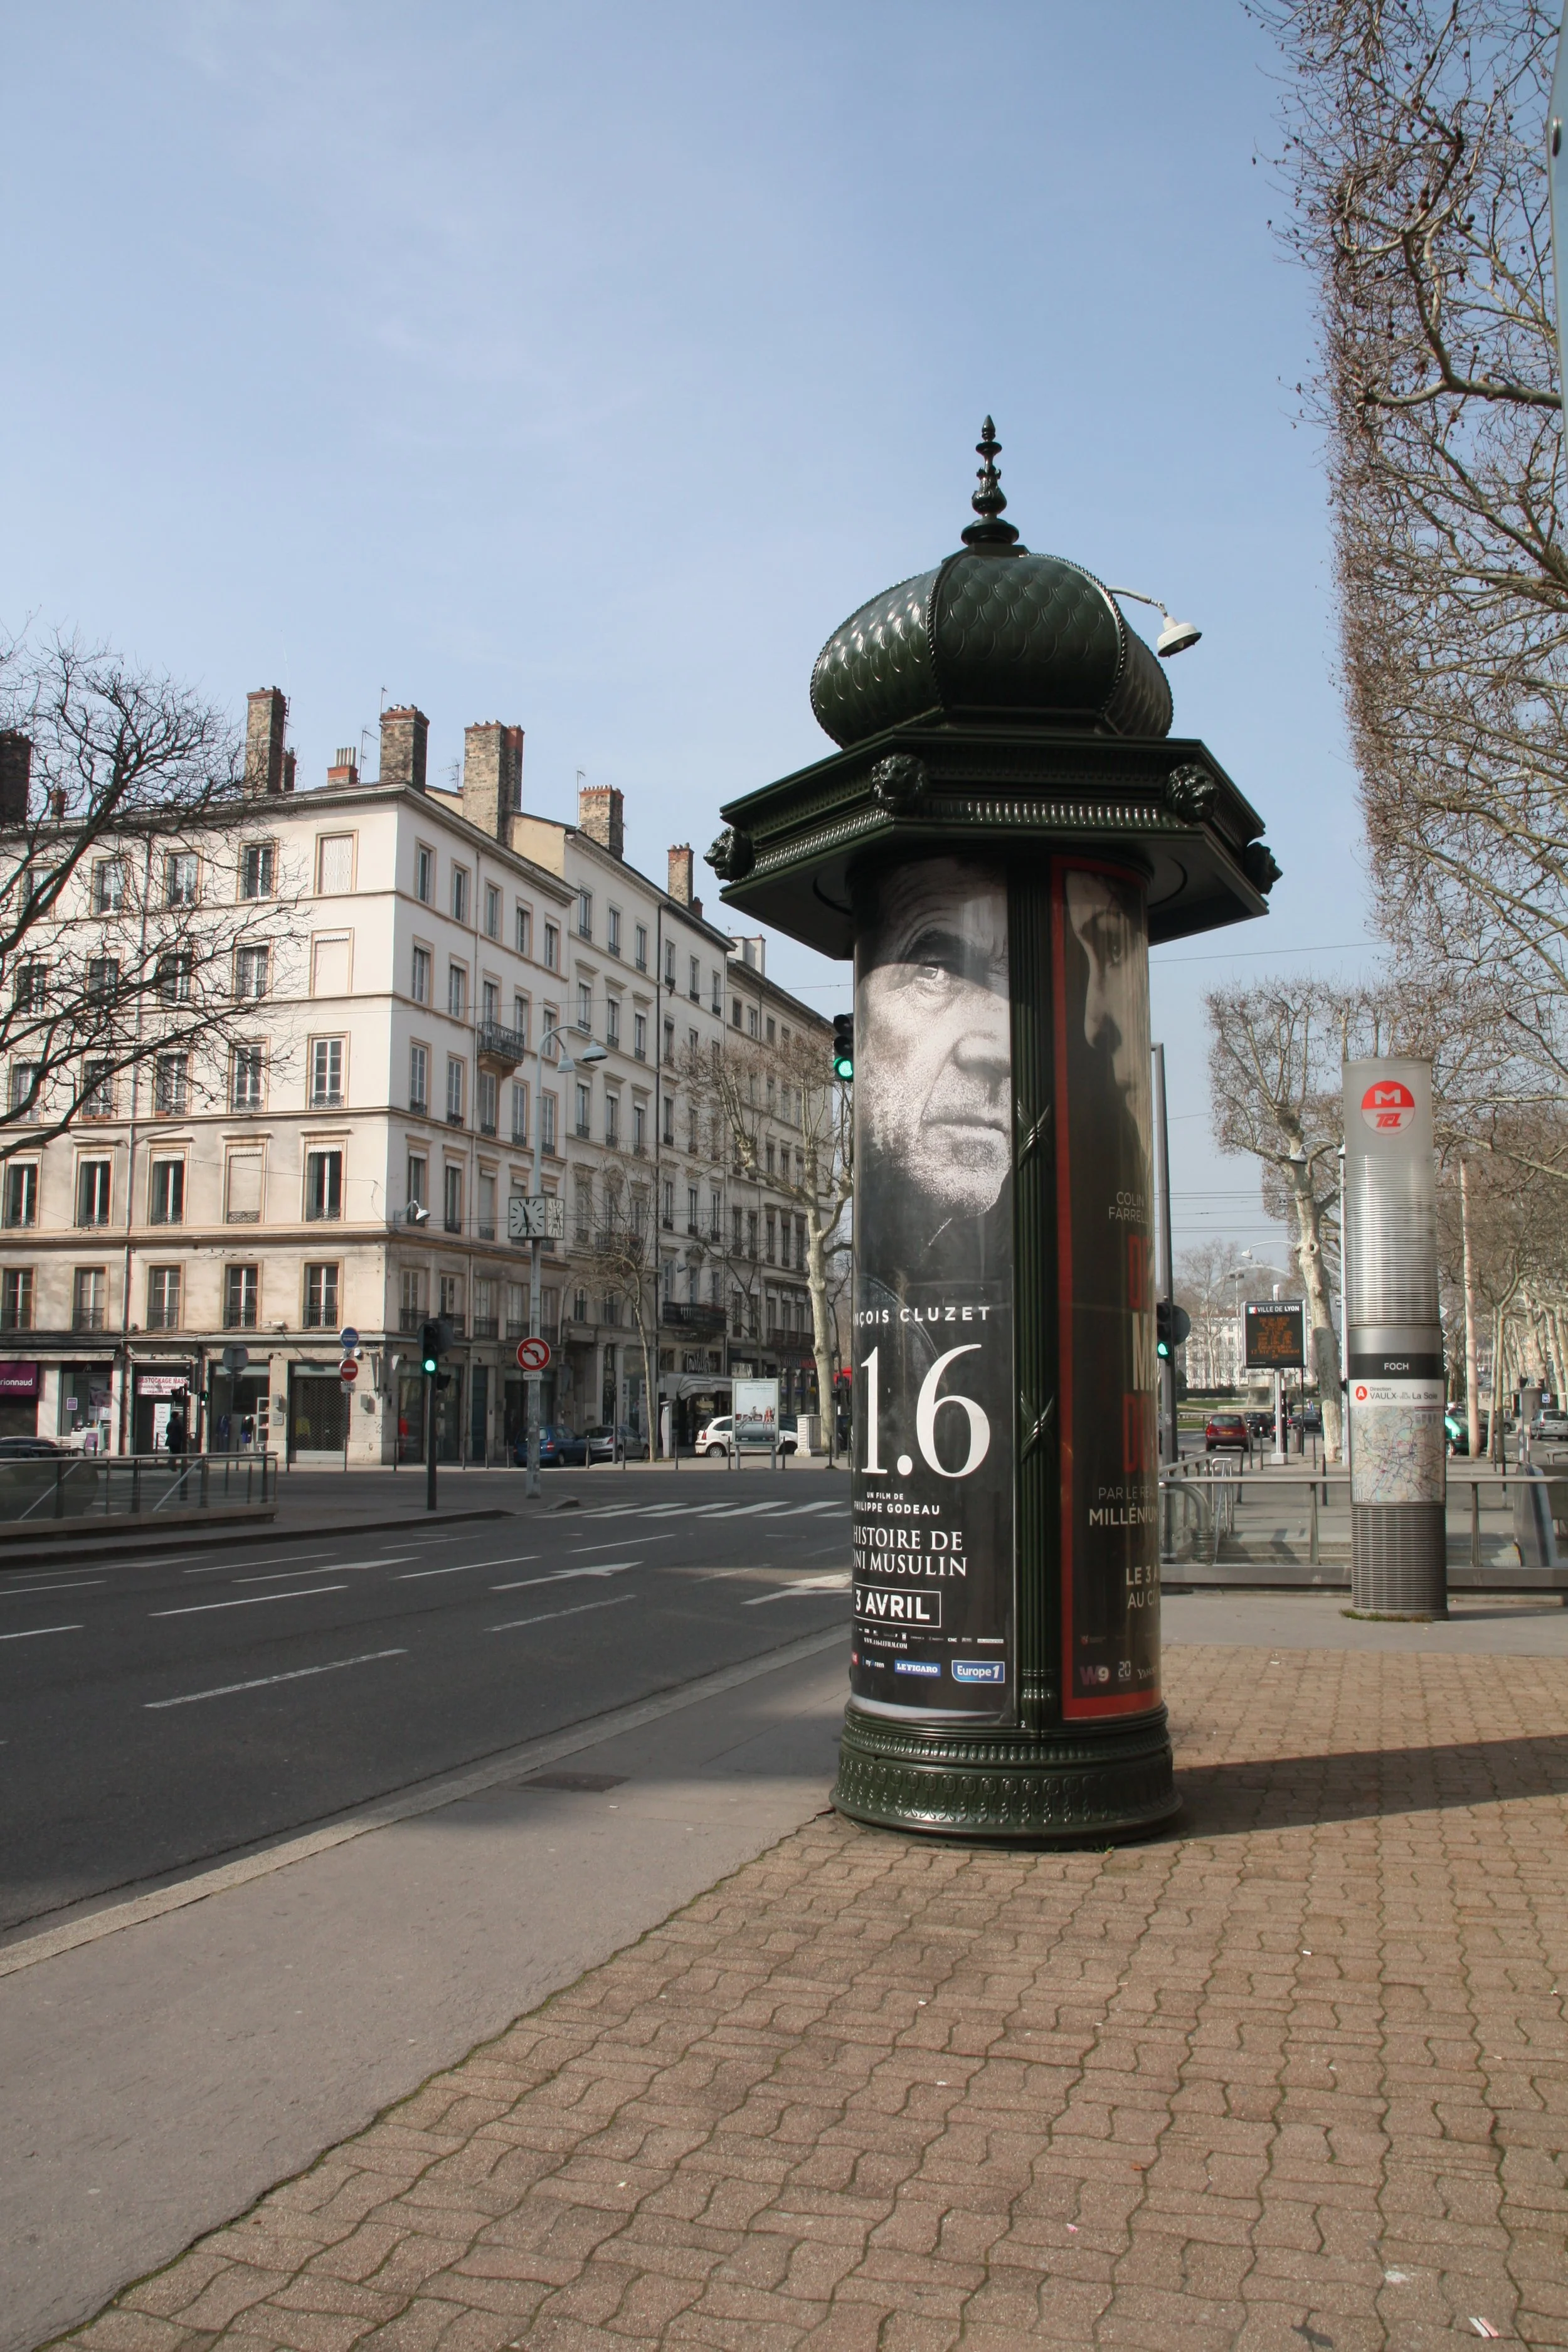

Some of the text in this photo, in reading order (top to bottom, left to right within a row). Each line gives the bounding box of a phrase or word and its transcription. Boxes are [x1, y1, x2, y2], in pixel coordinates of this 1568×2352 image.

[1375, 1089, 1401, 1104] M
[1376, 1113, 1401, 1128] TCL
[1116, 1191, 1144, 1207] COLIN
[900, 1306, 990, 1323] CLUZET
[1384, 1362, 1409, 1370] FOCH
[0, 1377, 33, 1386] rionnaud
[861, 1343, 990, 1478] 1.6
[1099, 1486, 1123, 1500] PAR
[1126, 1486, 1138, 1499] LE
[854, 1500, 940, 1515] PHILIPPE GODEAU
[930, 1530, 963, 1550] DE
[870, 1552, 967, 1576] MUSULIN
[1126, 1566, 1142, 1586] LE
[1146, 1565, 1152, 1583] 3
[856, 1589, 930, 1619] 3 AVRIL
[1127, 1591, 1144, 1609] AU
[897, 1663, 938, 1673] LE FIGARO
[1079, 1665, 1111, 1686] W9
[1118, 1660, 1131, 1677] 20
[1020, 1720, 1026, 1728] 2
